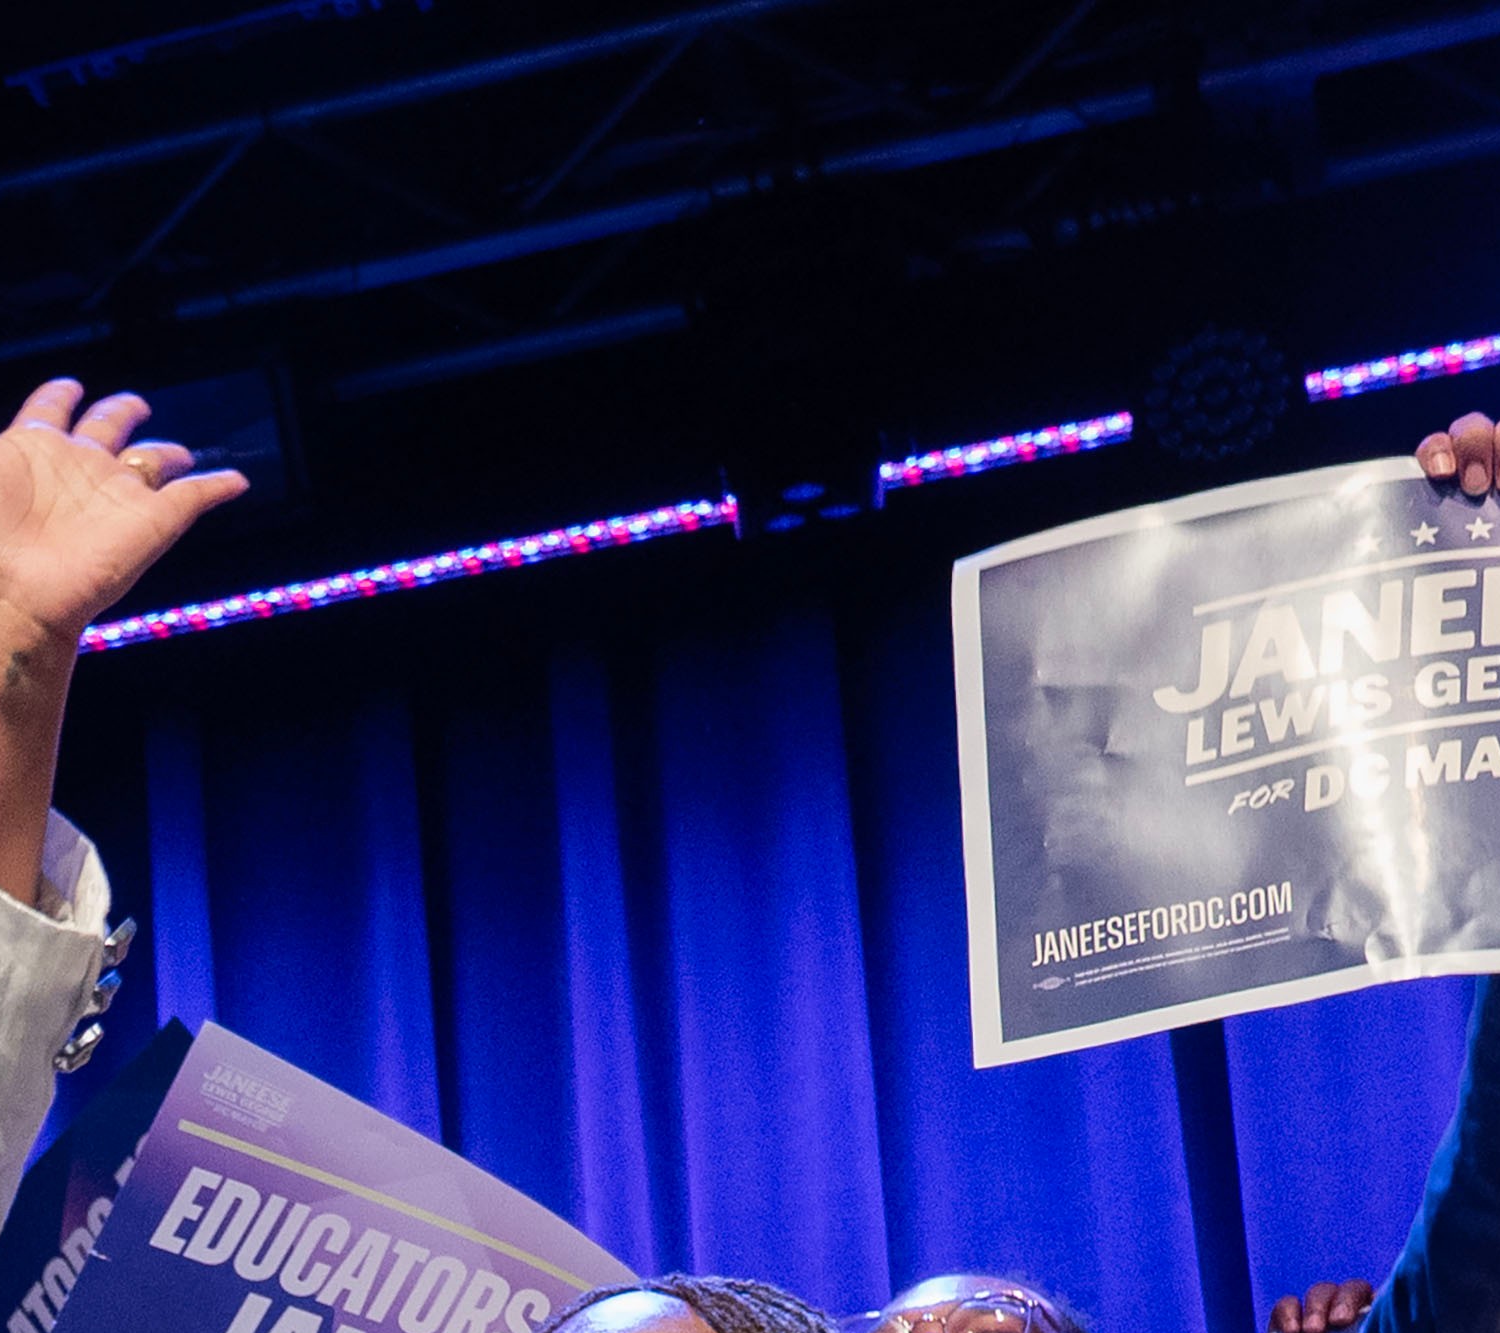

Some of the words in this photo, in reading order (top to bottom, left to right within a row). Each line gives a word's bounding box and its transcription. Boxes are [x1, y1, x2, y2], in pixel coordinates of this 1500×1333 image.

[1185, 669, 1393, 768] LEWIS
[1228, 778, 1296, 816] FOR
[1304, 751, 1391, 811] DC
[1032, 881, 1292, 967] JANEESEFORDC.COM
